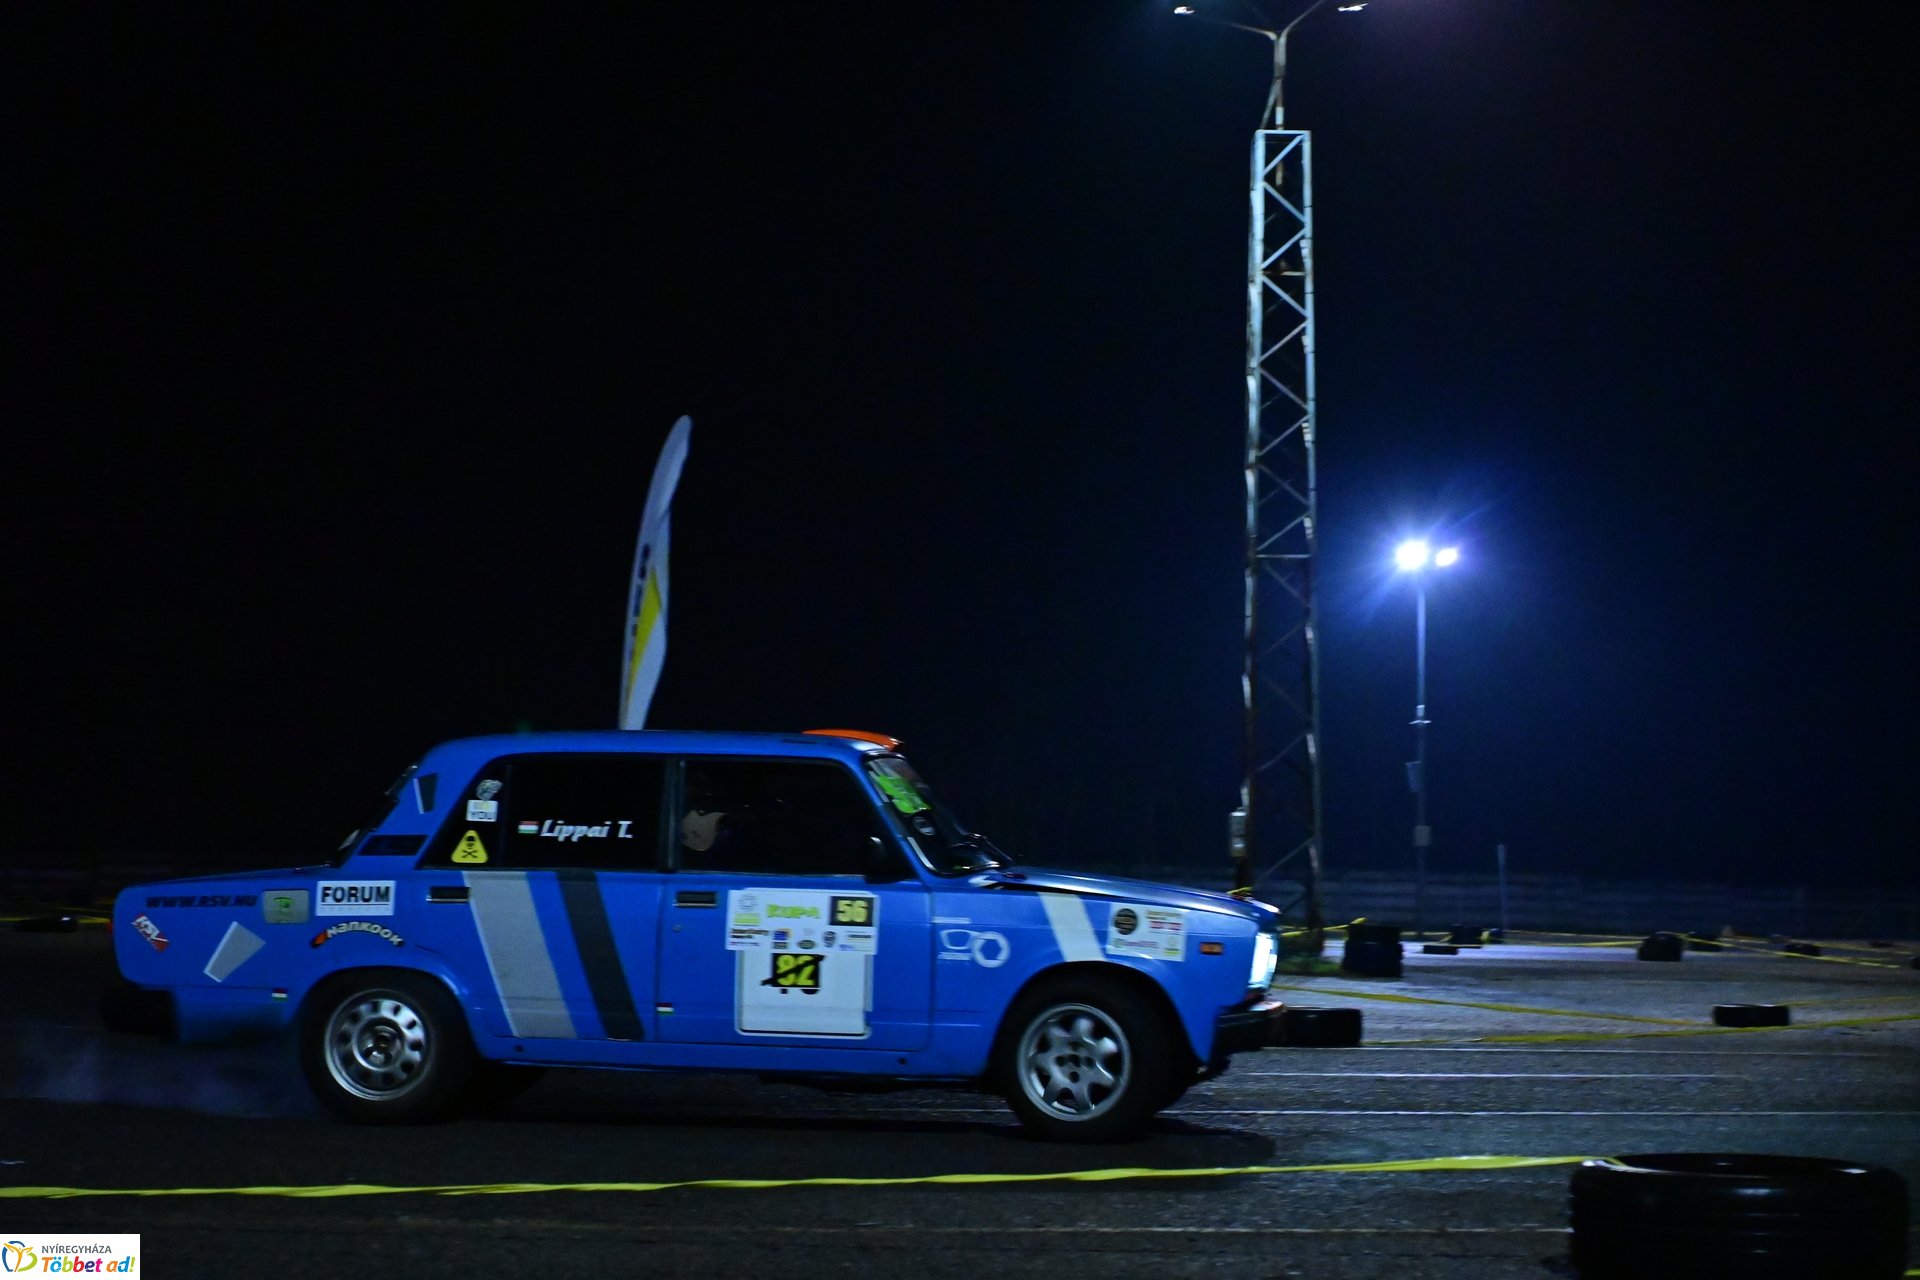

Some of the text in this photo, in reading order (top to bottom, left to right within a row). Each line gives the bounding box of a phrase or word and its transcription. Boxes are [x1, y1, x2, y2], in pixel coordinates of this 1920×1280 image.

[539, 819, 633, 843] Lippai T.
[321, 886, 391, 903] FORUM
[836, 899, 868, 923] 56
